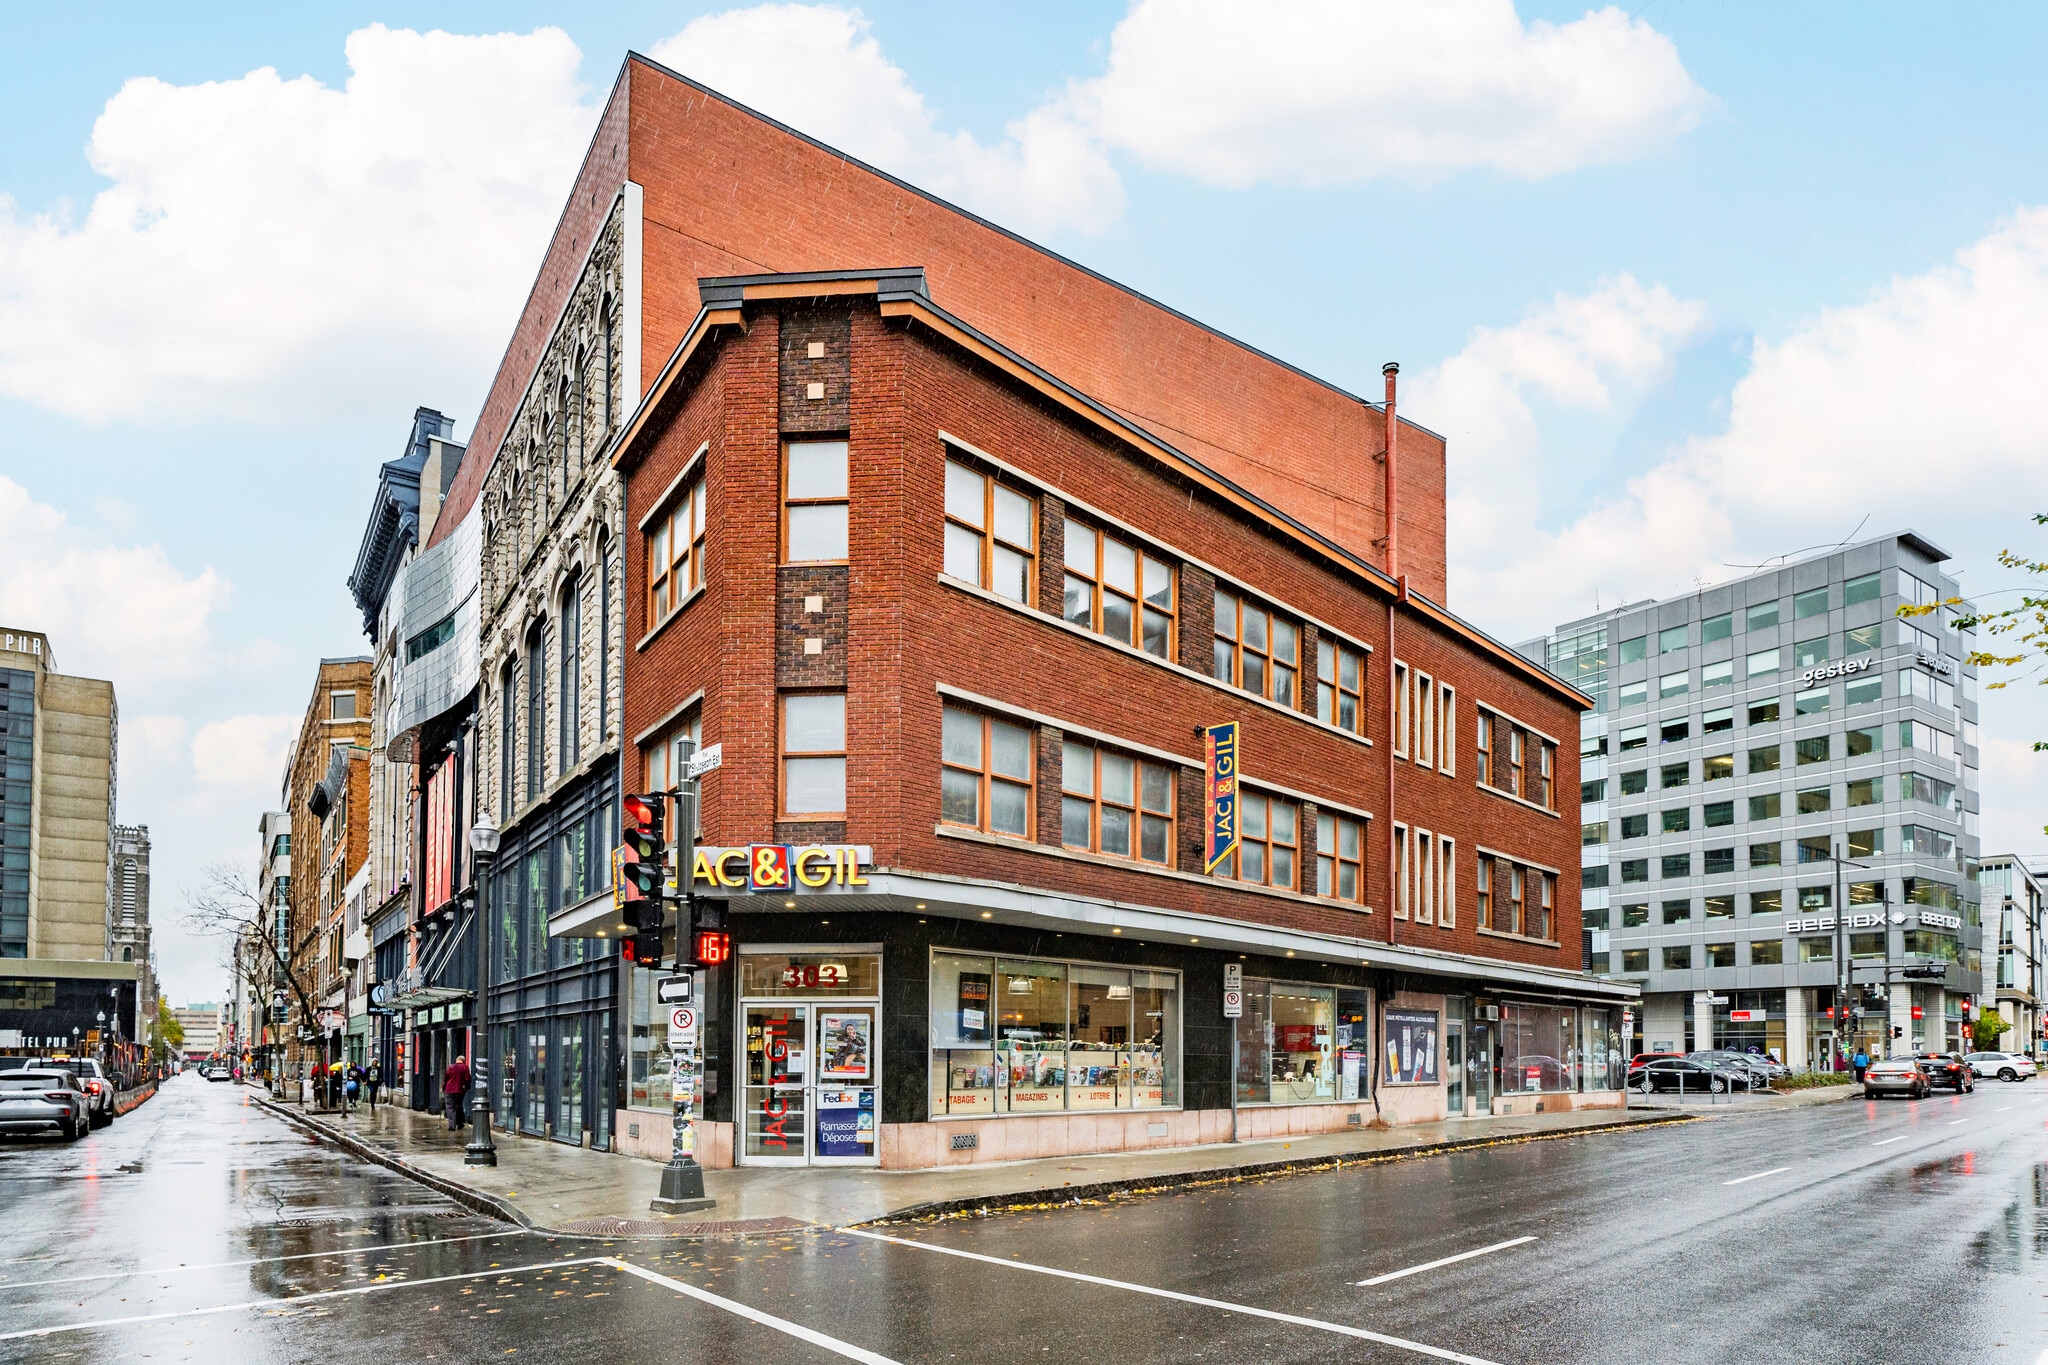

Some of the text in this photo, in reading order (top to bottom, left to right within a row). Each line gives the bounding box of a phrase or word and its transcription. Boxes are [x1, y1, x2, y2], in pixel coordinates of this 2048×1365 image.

[1802, 657, 1871, 688] gestev
[1207, 741, 1215, 836] TABAGIE
[1216, 733, 1233, 839] JAC & GIL
[753, 848, 786, 886] &
[796, 849, 869, 887] GIL
[703, 937, 719, 961] 16
[783, 965, 839, 988] 303
[46, 1037, 68, 1048] PUR
[765, 1012, 788, 1063] GIL
[1315, 992, 1332, 1097] FedEx
[823, 1092, 853, 1104] FedEx
[949, 1090, 1162, 1105] TABAGIE MAGAZINES LOTERIE BIÈRE
[764, 1098, 788, 1150] JAC
